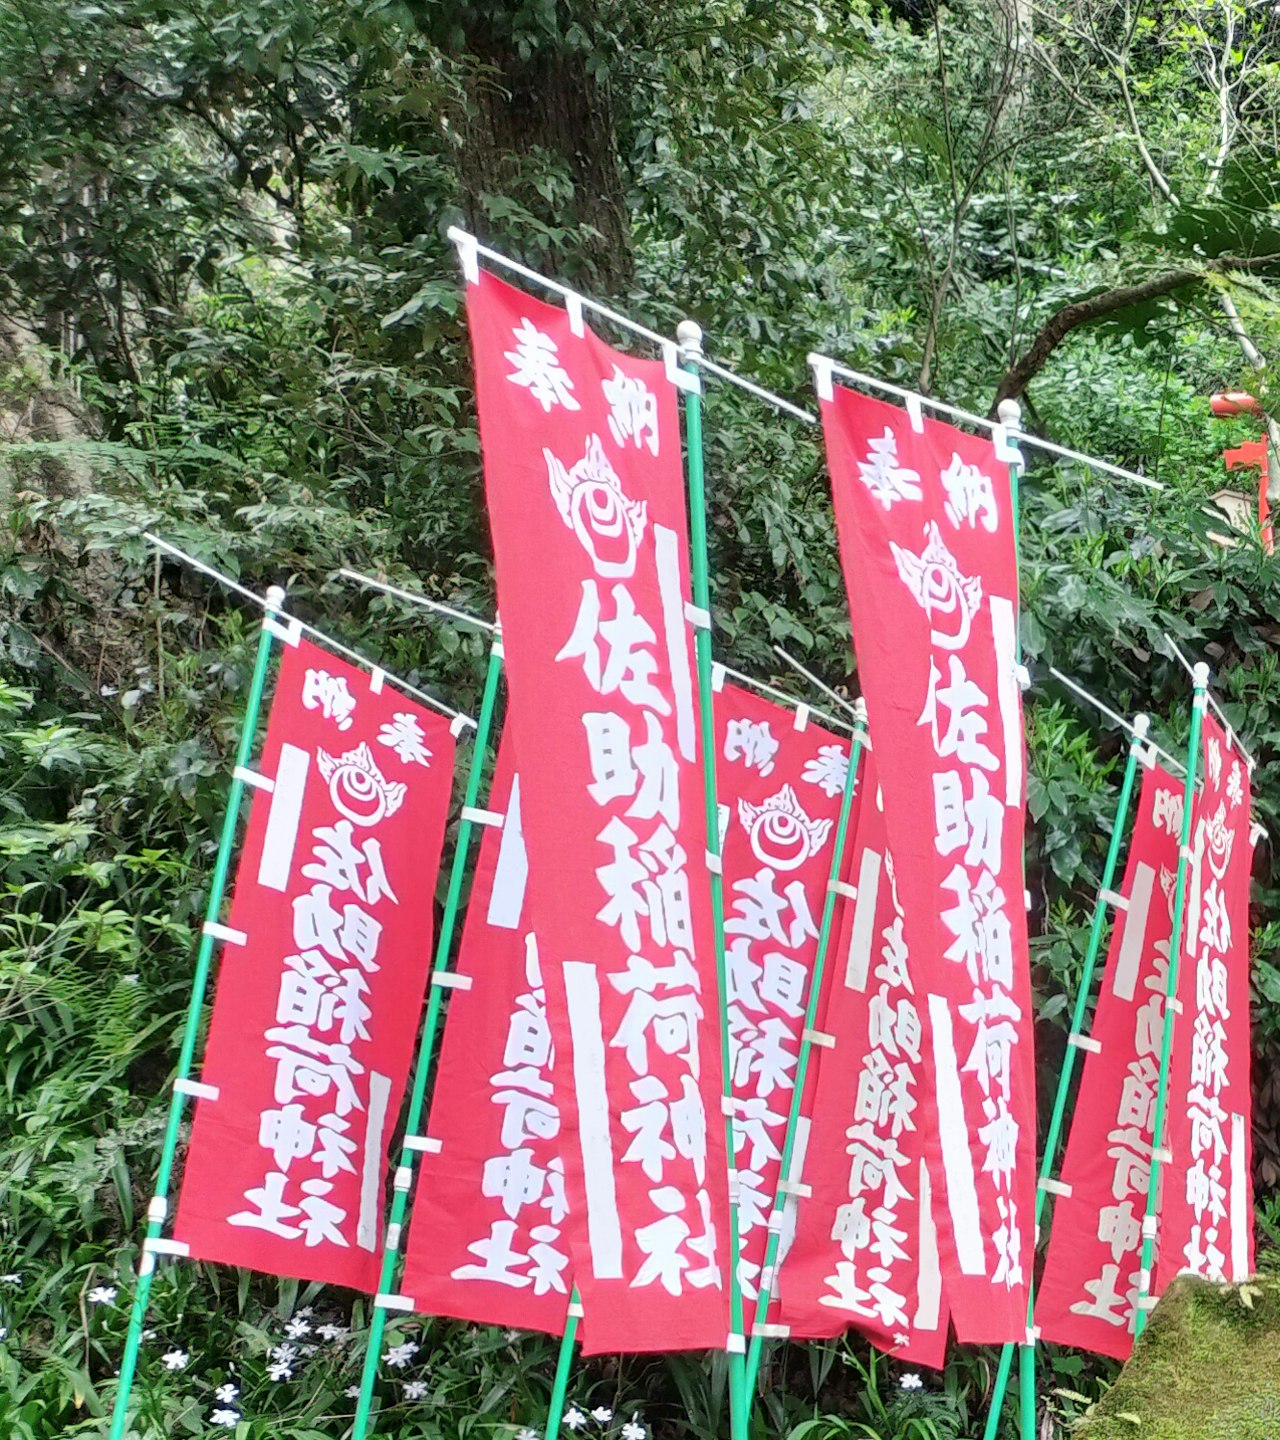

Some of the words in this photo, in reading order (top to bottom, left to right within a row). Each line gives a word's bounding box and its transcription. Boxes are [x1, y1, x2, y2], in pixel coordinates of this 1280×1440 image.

[504, 317, 660, 457] 奉納
[856, 426, 1001, 532] 奉納
[555, 579, 722, 1295] 佐助稲荷神社
[917, 656, 1023, 1292] 佐助稲荷神社
